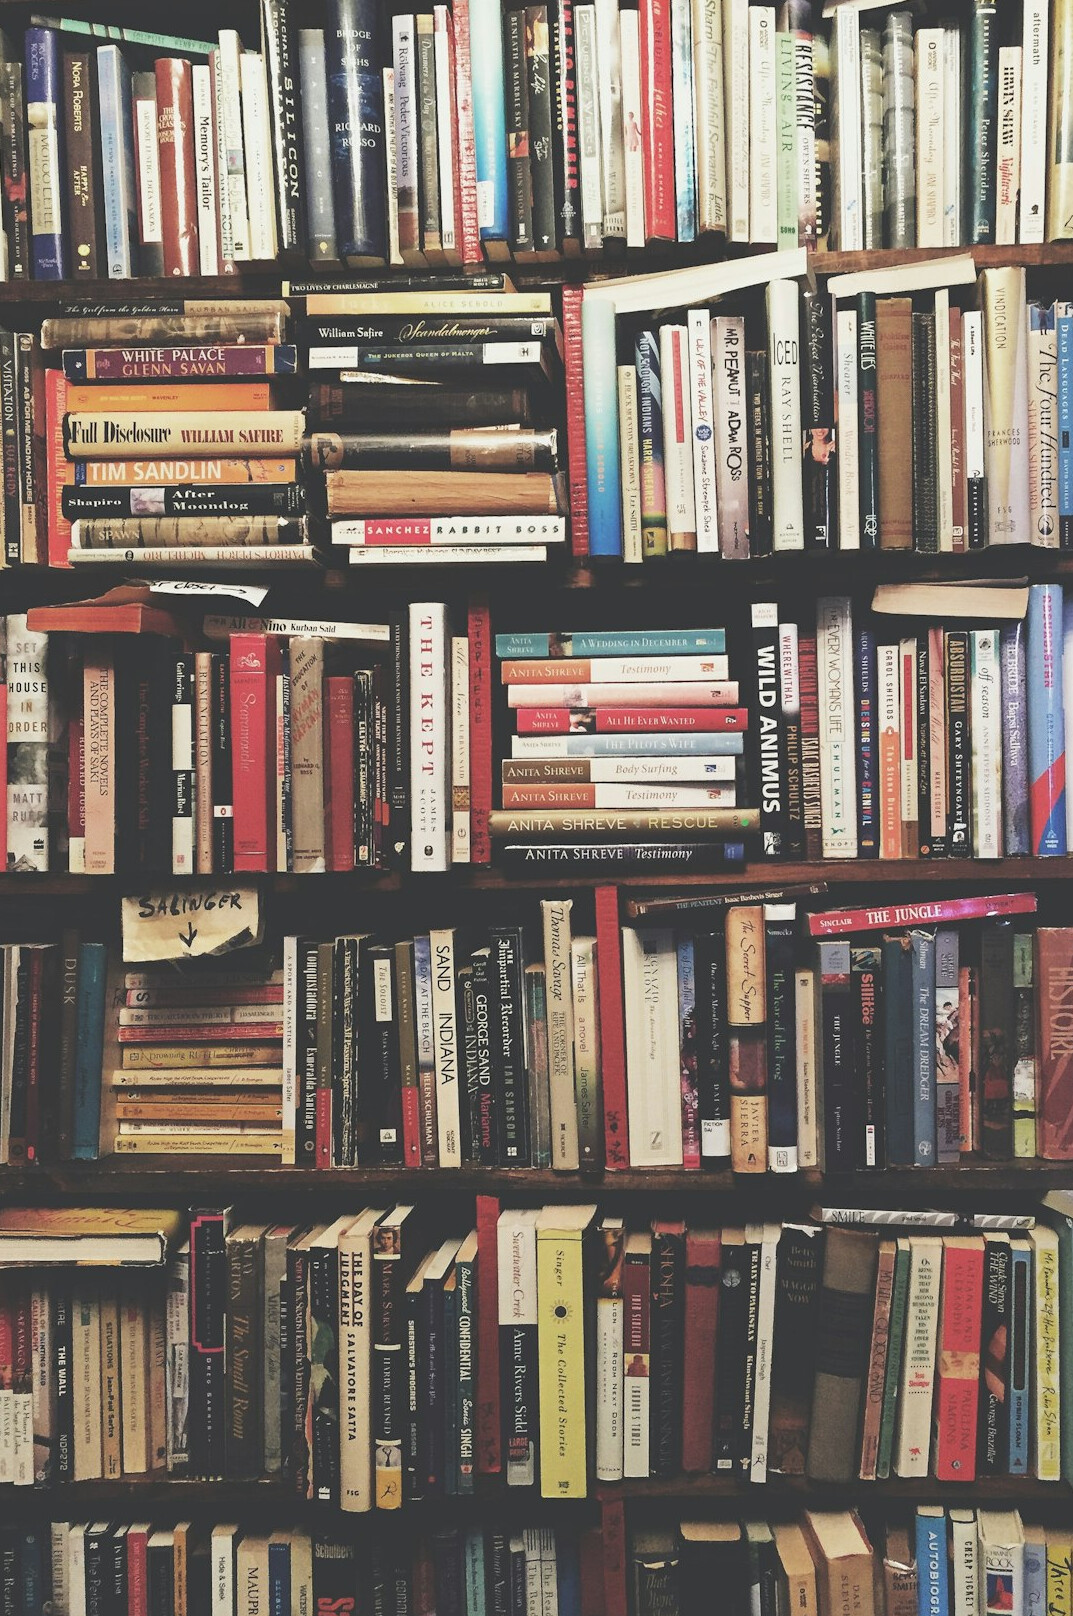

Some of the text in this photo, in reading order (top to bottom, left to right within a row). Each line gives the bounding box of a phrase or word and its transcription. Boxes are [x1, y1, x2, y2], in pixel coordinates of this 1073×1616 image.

[511, 16, 520, 60] BENEATH
[1032, 12, 1041, 65] aftermath
[421, 40, 431, 77] Dreamers
[72, 62, 84, 131] NORA ROBERTS
[400, 96, 410, 124] Peder
[421, 97, 433, 114] Day
[284, 77, 299, 198] SILICON
[400, 125, 411, 177] Victorious
[999, 67, 1014, 205] IRWIN SHAW Nightwork
[199, 116, 212, 210] Memory's Tailor
[979, 119, 990, 201] Peter Sheridan
[319, 320, 497, 342] William Safire Scandalmonger
[994, 288, 1006, 349] VINDICATION
[696, 339, 704, 358] LILY
[724, 329, 736, 348] MR.
[1061, 325, 1069, 352] DEAD
[122, 349, 225, 362] WHITE PALACE
[123, 363, 226, 376] GLENN SAVAN
[697, 360, 705, 371] OF
[697, 373, 706, 388] THE
[724, 351, 740, 397] PEANUT
[697, 390, 708, 422] VALLEY
[781, 377, 792, 464] RAY SHELL
[71, 421, 283, 444] Full Disclosure WILLIAM SAFIRE
[1036, 343, 1057, 509] The Four Hundred
[90, 461, 222, 481] TIM SANDLIN
[700, 445, 709, 475] Suzanne
[68, 499, 122, 507] Shapiro
[172, 490, 215, 499] After
[173, 501, 249, 511] Moondog
[99, 531, 140, 541] SPAWN
[367, 525, 559, 535] SANCHEZ RABBIT BOSS
[703, 515, 711, 532] Shea
[14, 663, 40, 672] THIS
[950, 640, 965, 713] ABSURDISTAN
[9, 683, 47, 692] HOUSE
[420, 616, 434, 776] THE KEPT
[979, 667, 993, 719] off season
[21, 703, 33, 712] IN
[861, 700, 870, 743] DRESSING
[9, 722, 47, 732] ORDER
[90, 681, 99, 783] AND PLAYS OF SAKI
[99, 670, 108, 796] THE COMPLETE NOVELS
[175, 662, 185, 814] Gatherings Marina Rust
[758, 645, 780, 813] WILD ANIMUS
[783, 636, 800, 820] WHEREWITHAL PHILIP SCHULTZ
[861, 747, 870, 758] UP
[863, 760, 871, 769] for
[508, 763, 678, 777] ANITA SHREVE Body Surfing
[13, 793, 43, 803] MATT
[510, 790, 678, 802] ANITA SHREVE Testimony
[862, 782, 872, 826] CARNIVAL
[508, 817, 718, 831] ANITA SHREVE RESCUE
[525, 848, 692, 859] ANITA SHREVE Testimony
[139, 893, 242, 918] SALINGER
[866, 911, 892, 925] THE
[894, 905, 942, 923] JUNGLE
[550, 907, 566, 1001] Thomas Savage
[576, 955, 585, 969] All
[64, 958, 77, 1005] DUSK
[577, 971, 586, 992] That
[578, 995, 586, 1003] Is
[436, 946, 455, 1085] SAND INDIANA
[304, 950, 317, 1129] Conquistadora Esmeralda Santiago
[579, 1026, 589, 1053] novel
[920, 987, 929, 1101] The DREAM DREDGER
[463, 1035, 479, 1095] INDIANA
[476, 995, 491, 1148] GEORGE SAND Marianne
[580, 1067, 590, 1099] James
[581, 1101, 590, 1129] Salter
[340, 1252, 350, 1327] JUDGMENT
[353, 1252, 363, 1327] THE DAY OF
[989, 1252, 998, 1304] THE WIND
[512, 1231, 527, 1433] Sweetwater Creek Anne Rivers Sidd
[458, 1267, 472, 1457] Bollywood CONFIDENTIAL Sonia SINGH
[555, 1250, 567, 1457] Singer The Collected Stories
[58, 1369, 66, 1396] WALL
[347, 1333, 356, 1441] SALVATORE SATTA
[928, 1531, 940, 1616] AUTOBIOGR
[965, 1541, 974, 1608] CHEAP TICKET
